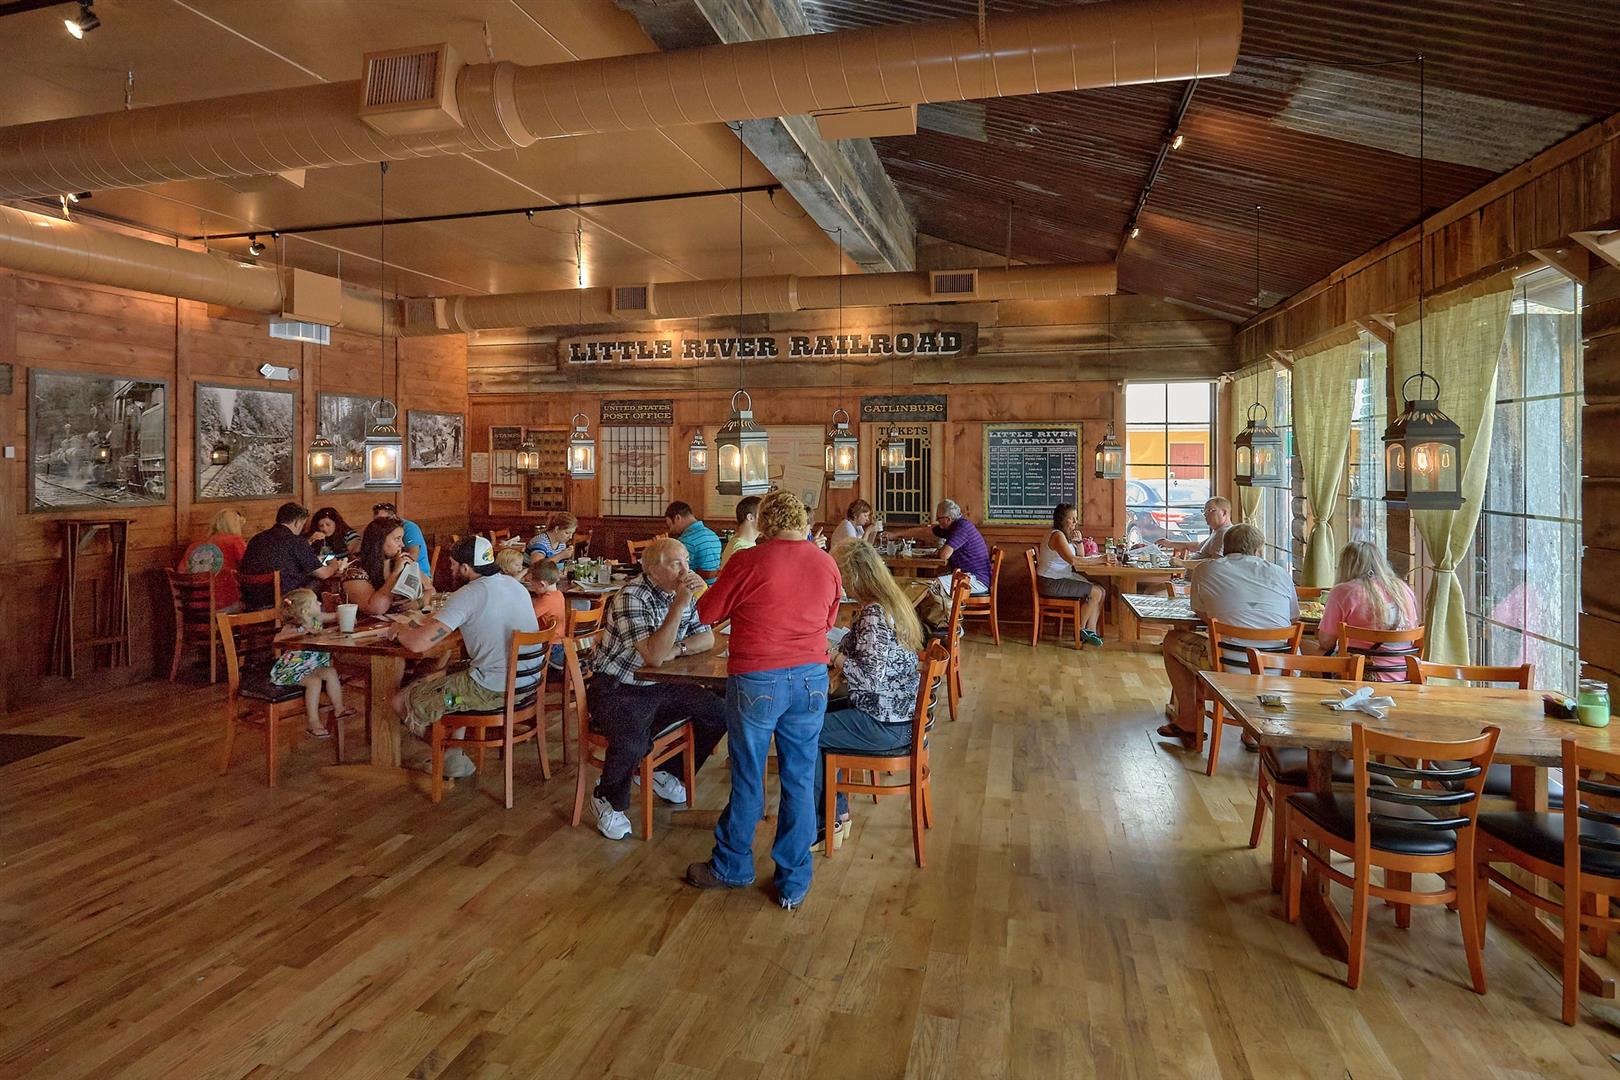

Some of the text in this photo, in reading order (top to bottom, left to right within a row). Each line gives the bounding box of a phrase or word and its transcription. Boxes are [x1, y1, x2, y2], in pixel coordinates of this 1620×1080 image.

[568, 332, 962, 363] LITTLE RIVER RAILROAD
[863, 404, 944, 413] GATLINBURG
[632, 412, 672, 420] OFFICE
[609, 485, 665, 496] CLOSED
